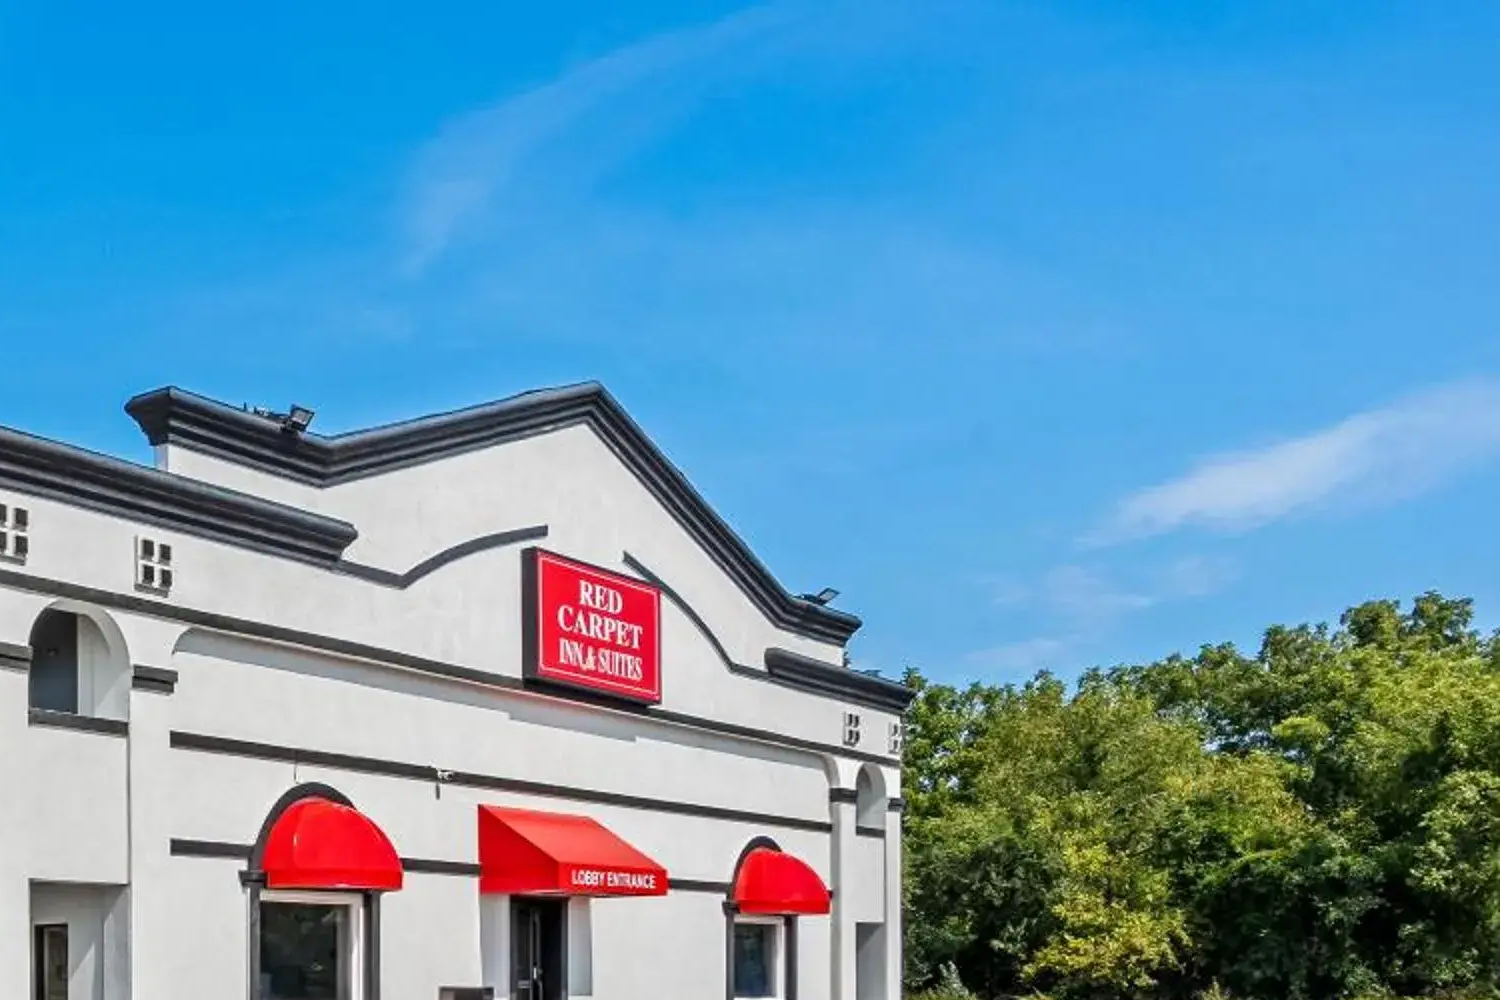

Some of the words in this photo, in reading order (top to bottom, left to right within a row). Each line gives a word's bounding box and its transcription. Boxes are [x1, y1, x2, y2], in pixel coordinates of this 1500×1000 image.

[579, 579, 624, 615] RED
[557, 604, 644, 650] CARPET
[558, 637, 584, 667] INN
[597, 648, 644, 682] SUITES
[571, 869, 605, 887] LOBBY
[607, 871, 657, 889] ENTRANCE
